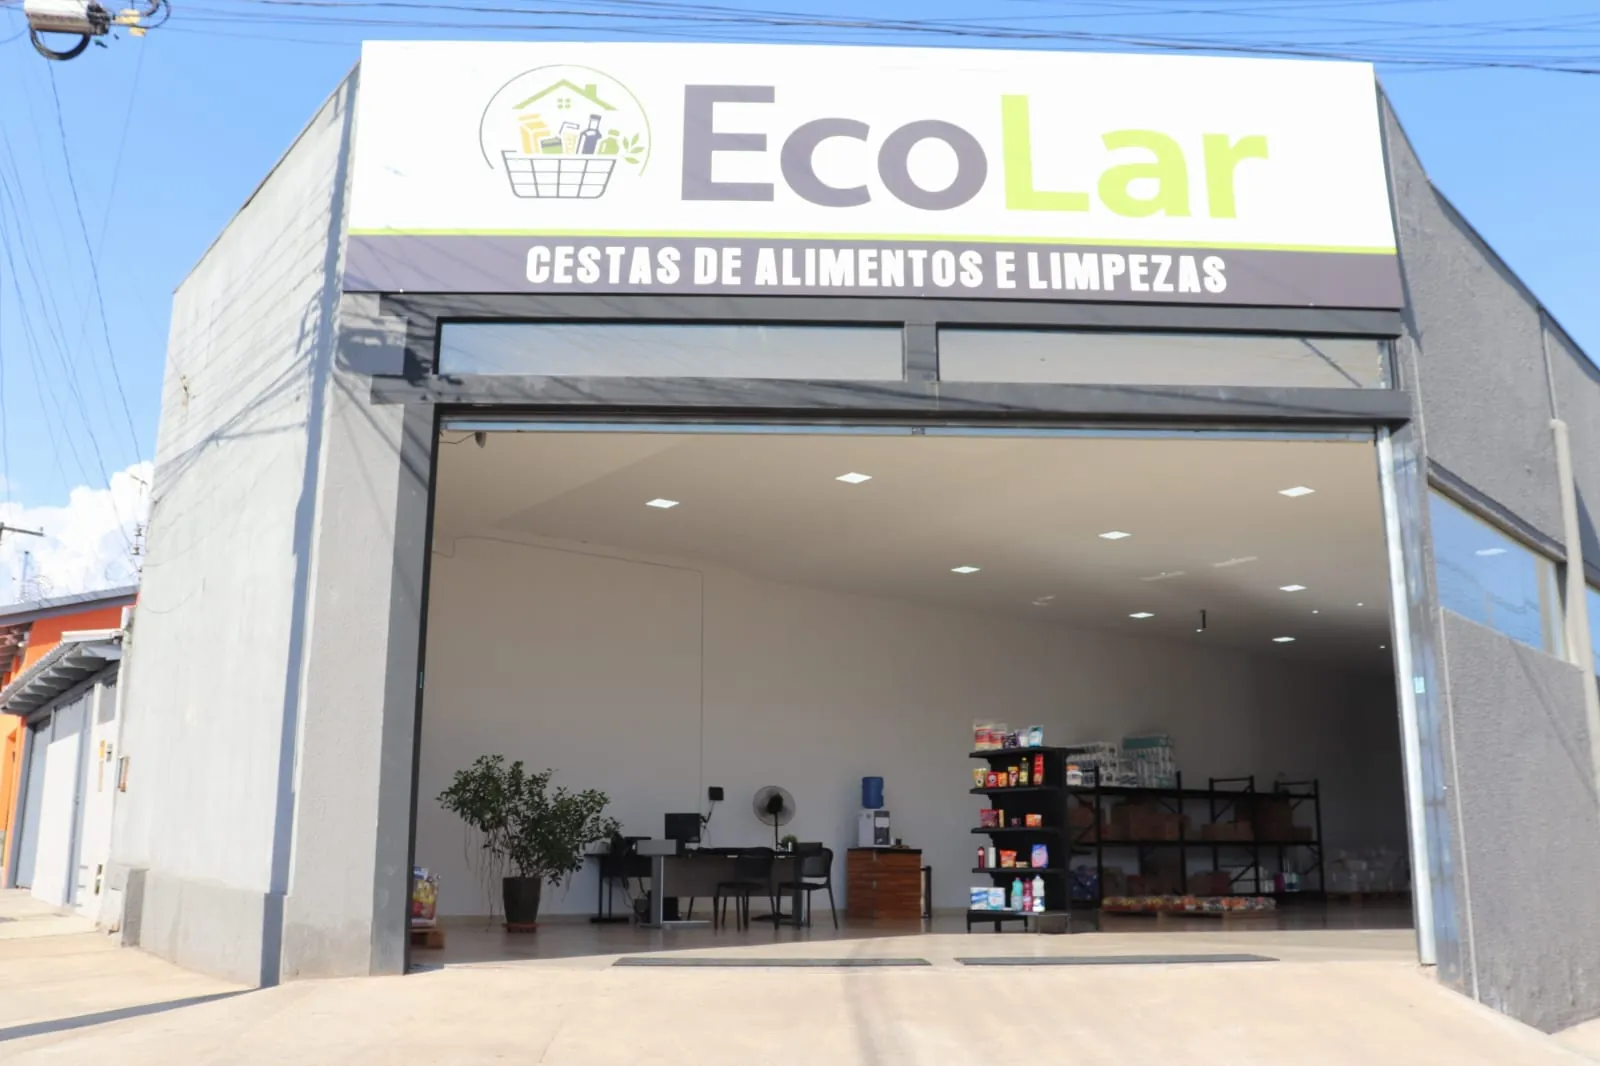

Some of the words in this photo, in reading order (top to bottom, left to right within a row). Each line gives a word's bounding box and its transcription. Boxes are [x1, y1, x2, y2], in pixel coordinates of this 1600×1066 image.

[681, 84, 1269, 219] EcoLar
[525, 245, 681, 285] CESTAS
[694, 247, 741, 285] DE
[754, 248, 983, 289] ALIMENTOS
[996, 251, 1017, 290] E
[1028, 252, 1228, 293] LIMPEZAS
